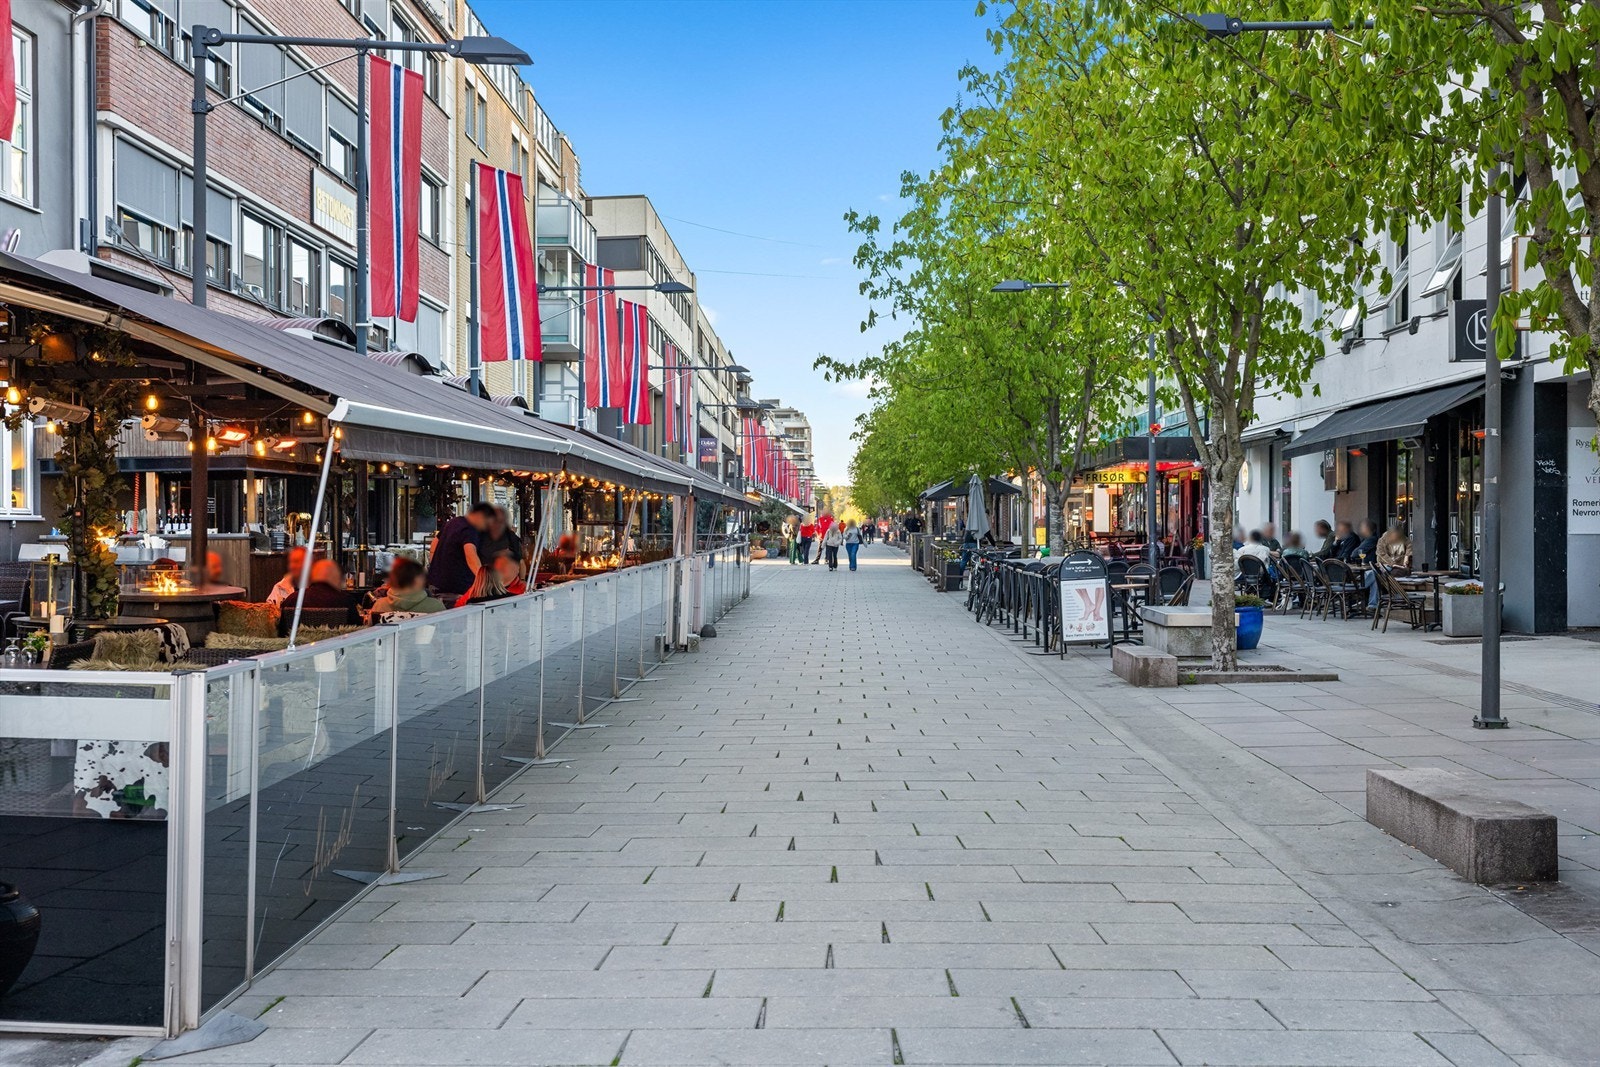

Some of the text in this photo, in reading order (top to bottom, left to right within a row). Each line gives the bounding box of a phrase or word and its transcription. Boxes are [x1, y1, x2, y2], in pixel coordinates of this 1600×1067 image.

[1575, 439, 1591, 448] Ryg
[1085, 471, 1125, 482] FRISØR
[1572, 508, 1600, 517] Nevror
